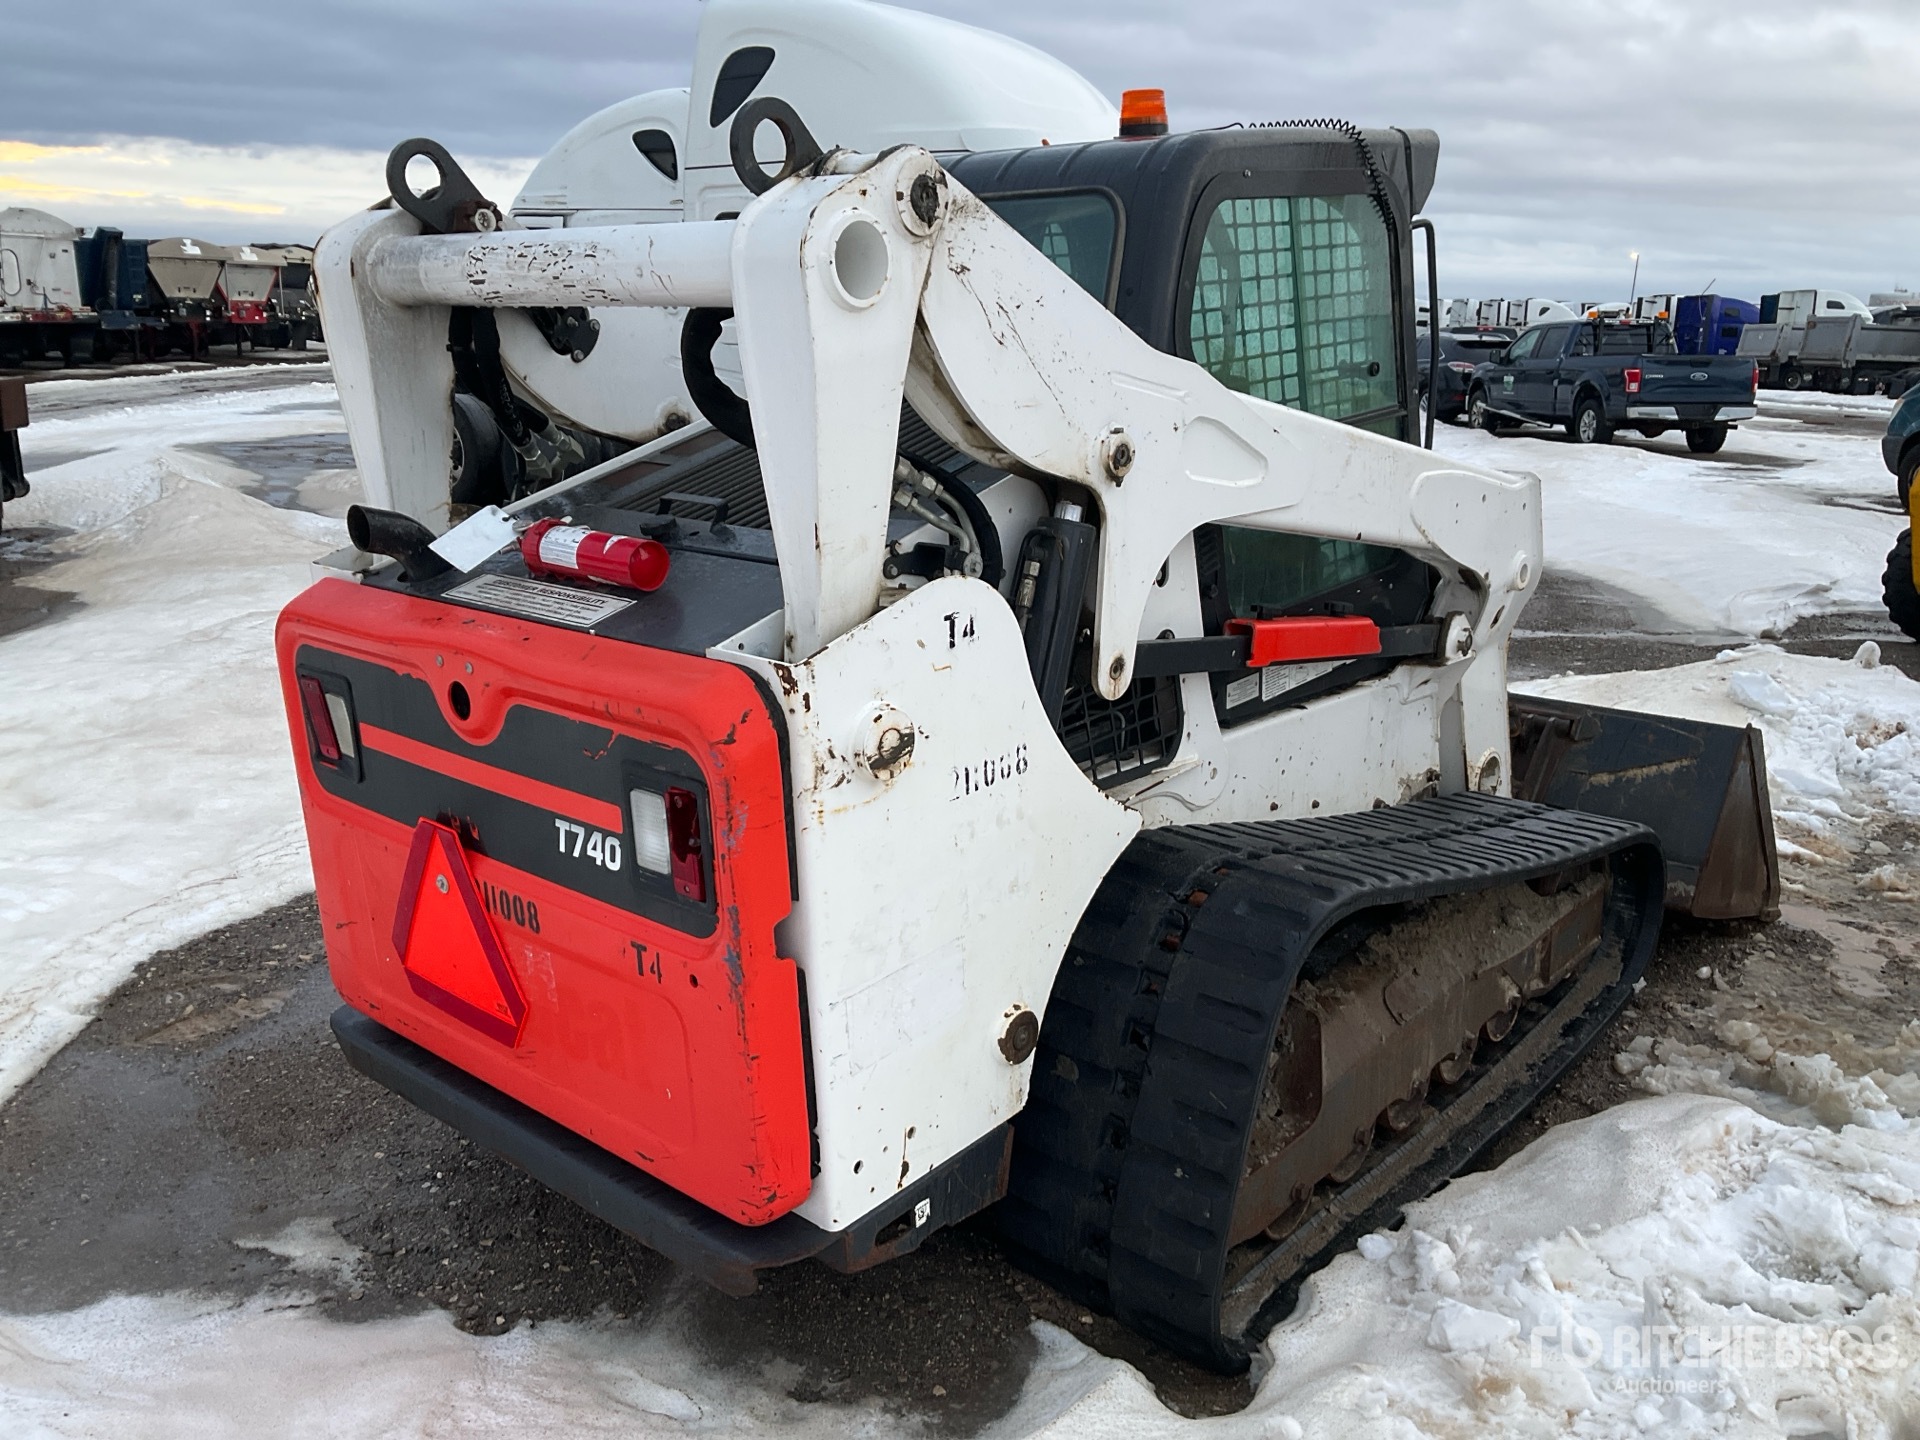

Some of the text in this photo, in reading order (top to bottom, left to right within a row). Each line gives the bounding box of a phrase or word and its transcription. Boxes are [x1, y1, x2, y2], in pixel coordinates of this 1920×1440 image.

[492, 579, 609, 605] CUSTOMER RESPONSIBILITY
[555, 818, 622, 872] T740
[630, 940, 663, 985] T4
